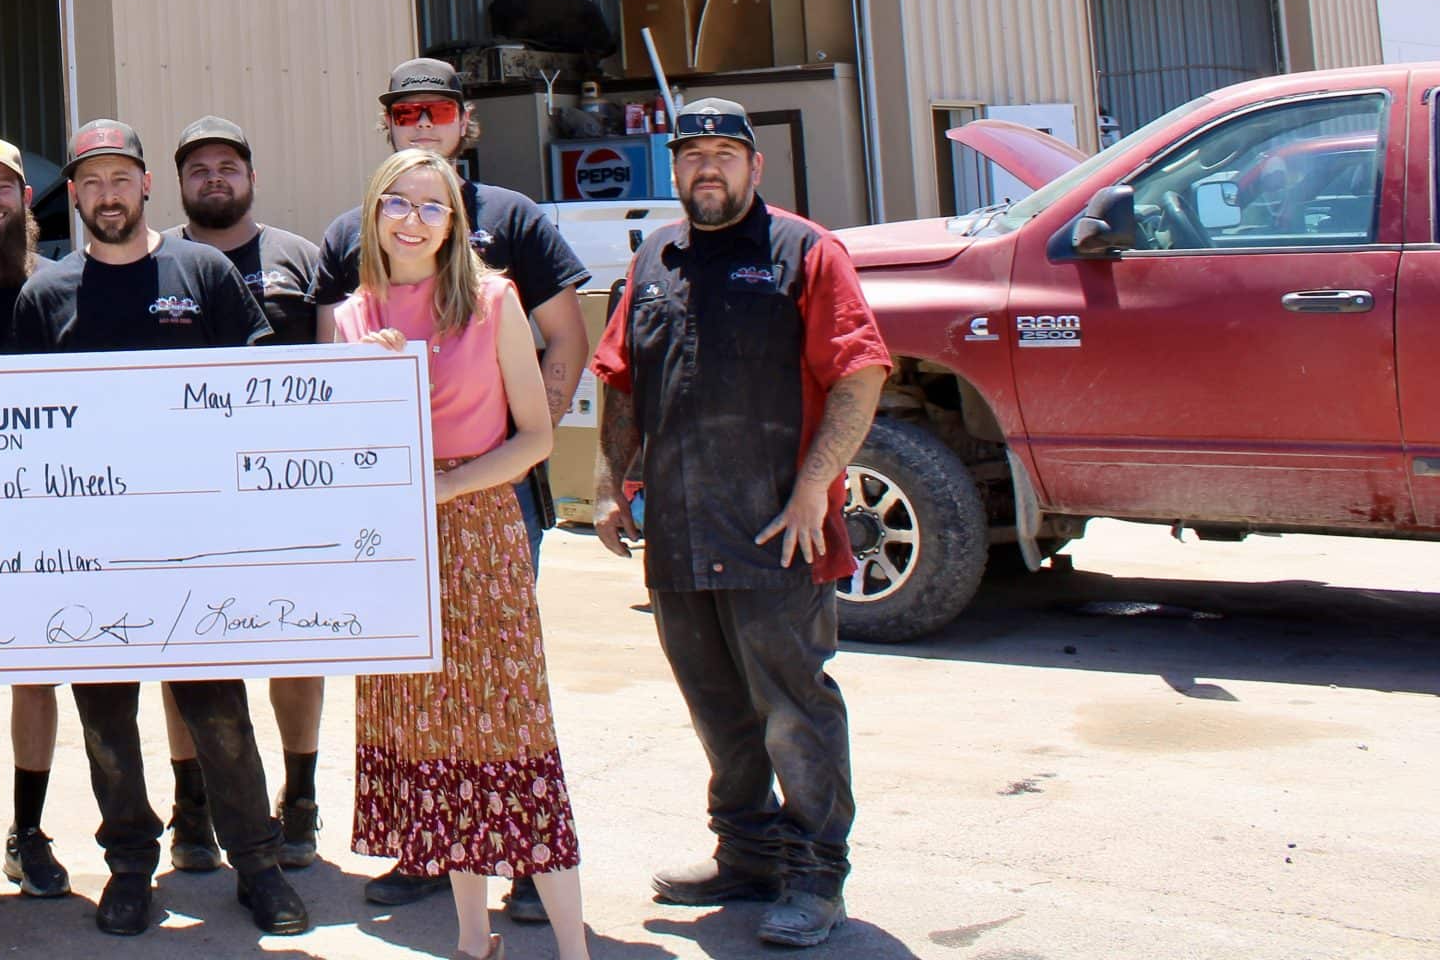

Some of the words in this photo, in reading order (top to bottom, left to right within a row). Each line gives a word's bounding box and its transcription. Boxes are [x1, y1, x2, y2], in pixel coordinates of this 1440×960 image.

[577, 166, 631, 185] PEPSI
[1016, 315, 1081, 330] RAM
[1022, 330, 1077, 340] 2500
[184, 382, 233, 418] May
[4, 466, 31, 500] of
[44, 463, 127, 498] Wheels
[34, 548, 102, 574] dollars
